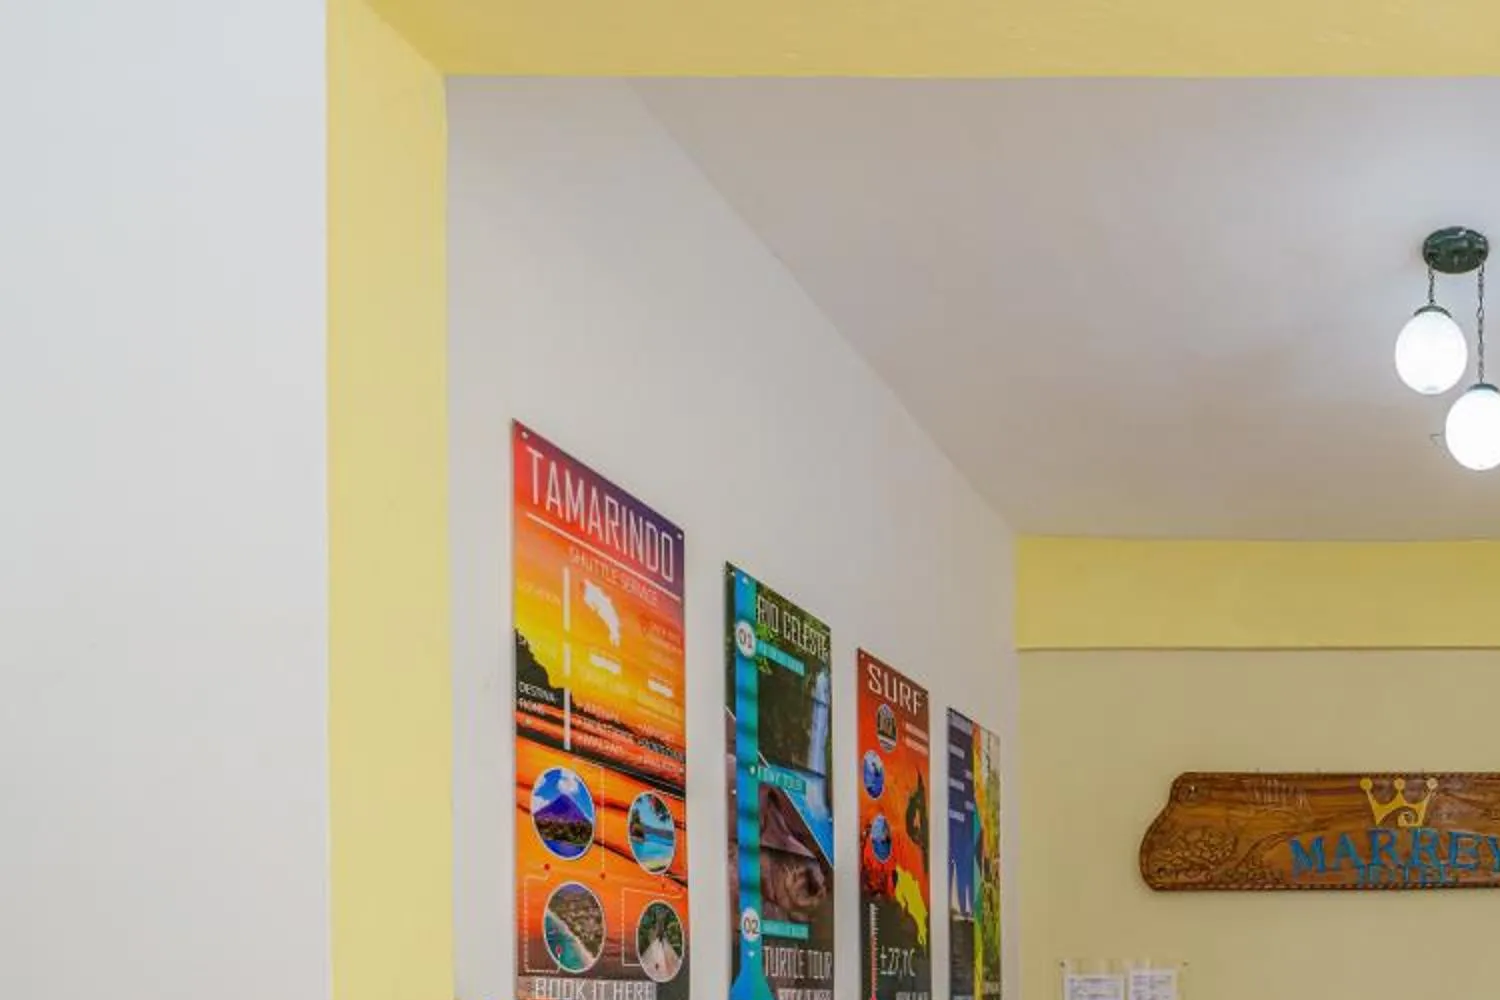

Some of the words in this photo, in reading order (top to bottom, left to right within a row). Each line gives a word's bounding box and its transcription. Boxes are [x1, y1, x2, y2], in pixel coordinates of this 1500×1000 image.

[526, 445, 674, 581] TAMARINDO
[782, 610, 830, 664] CELESTE
[867, 663, 924, 717] SURF
[743, 916, 761, 935] 02
[763, 945, 805, 979] TURTLE
[807, 948, 833, 981] TOUR
